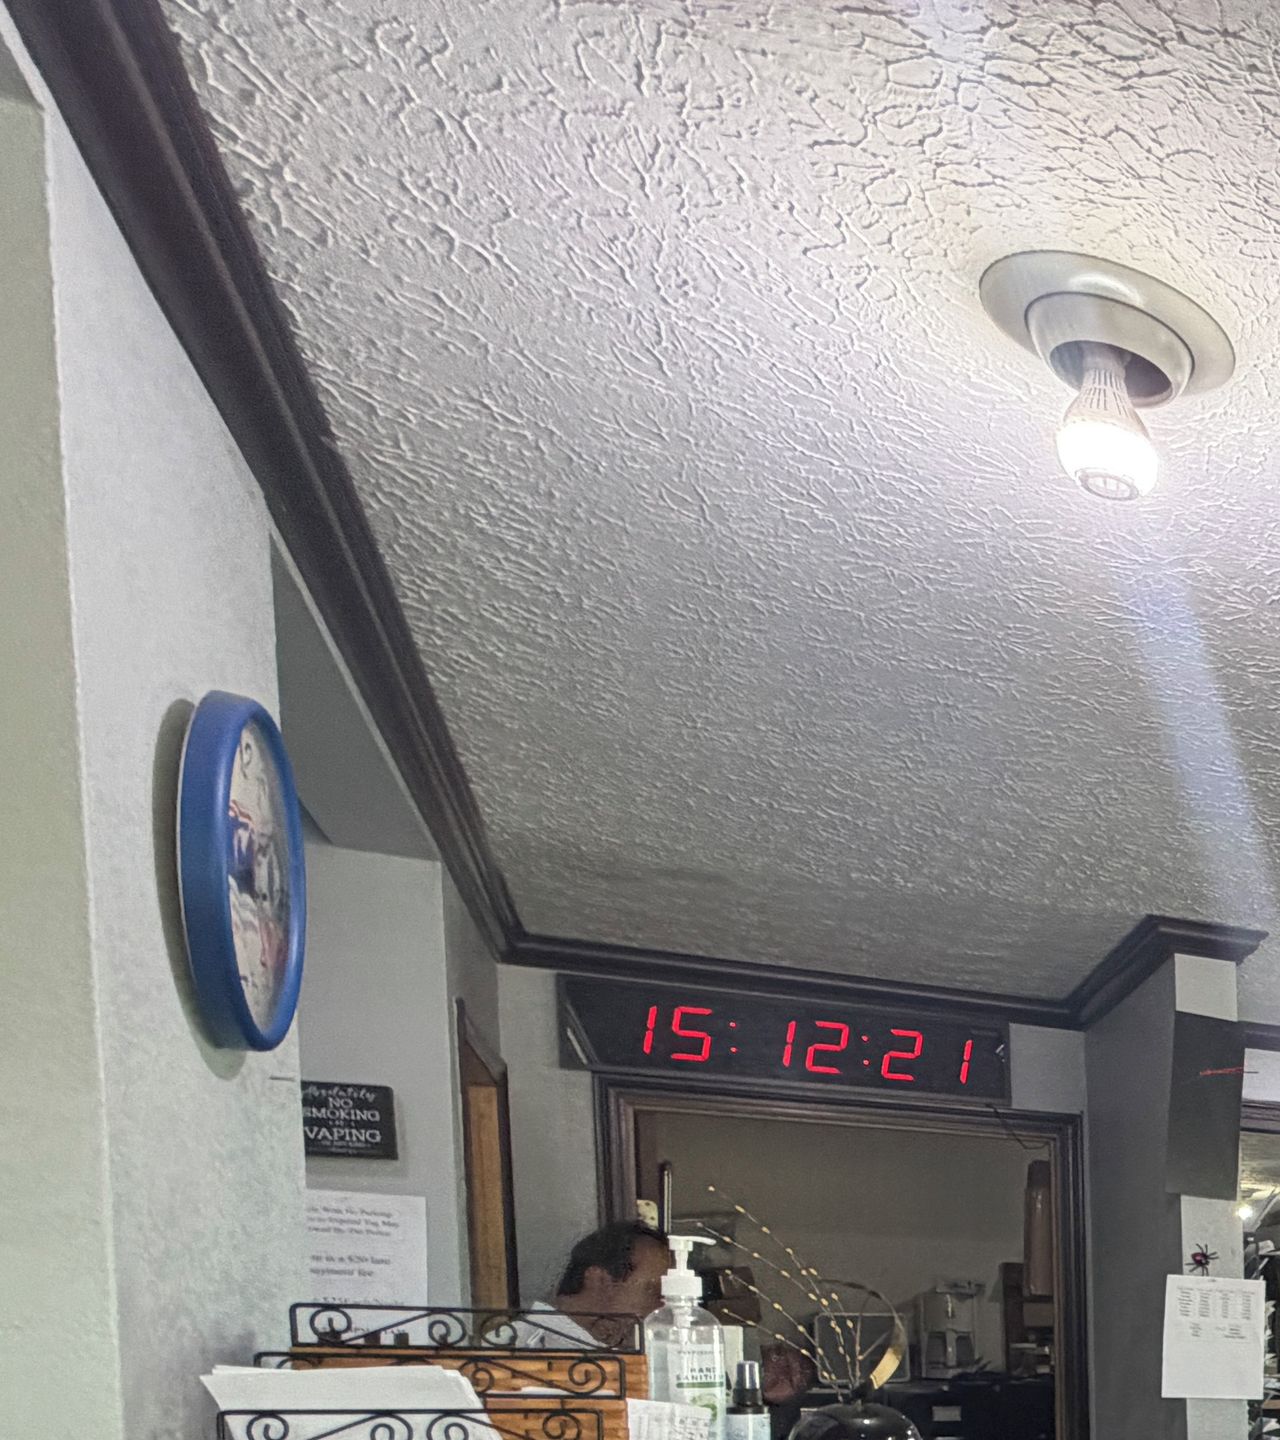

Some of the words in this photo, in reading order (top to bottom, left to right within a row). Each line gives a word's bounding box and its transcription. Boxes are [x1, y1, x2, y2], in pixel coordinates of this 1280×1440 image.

[643, 1005, 973, 1084] 15:12:21
[328, 1096, 353, 1108] NO
[304, 1126, 382, 1143] VAPING
